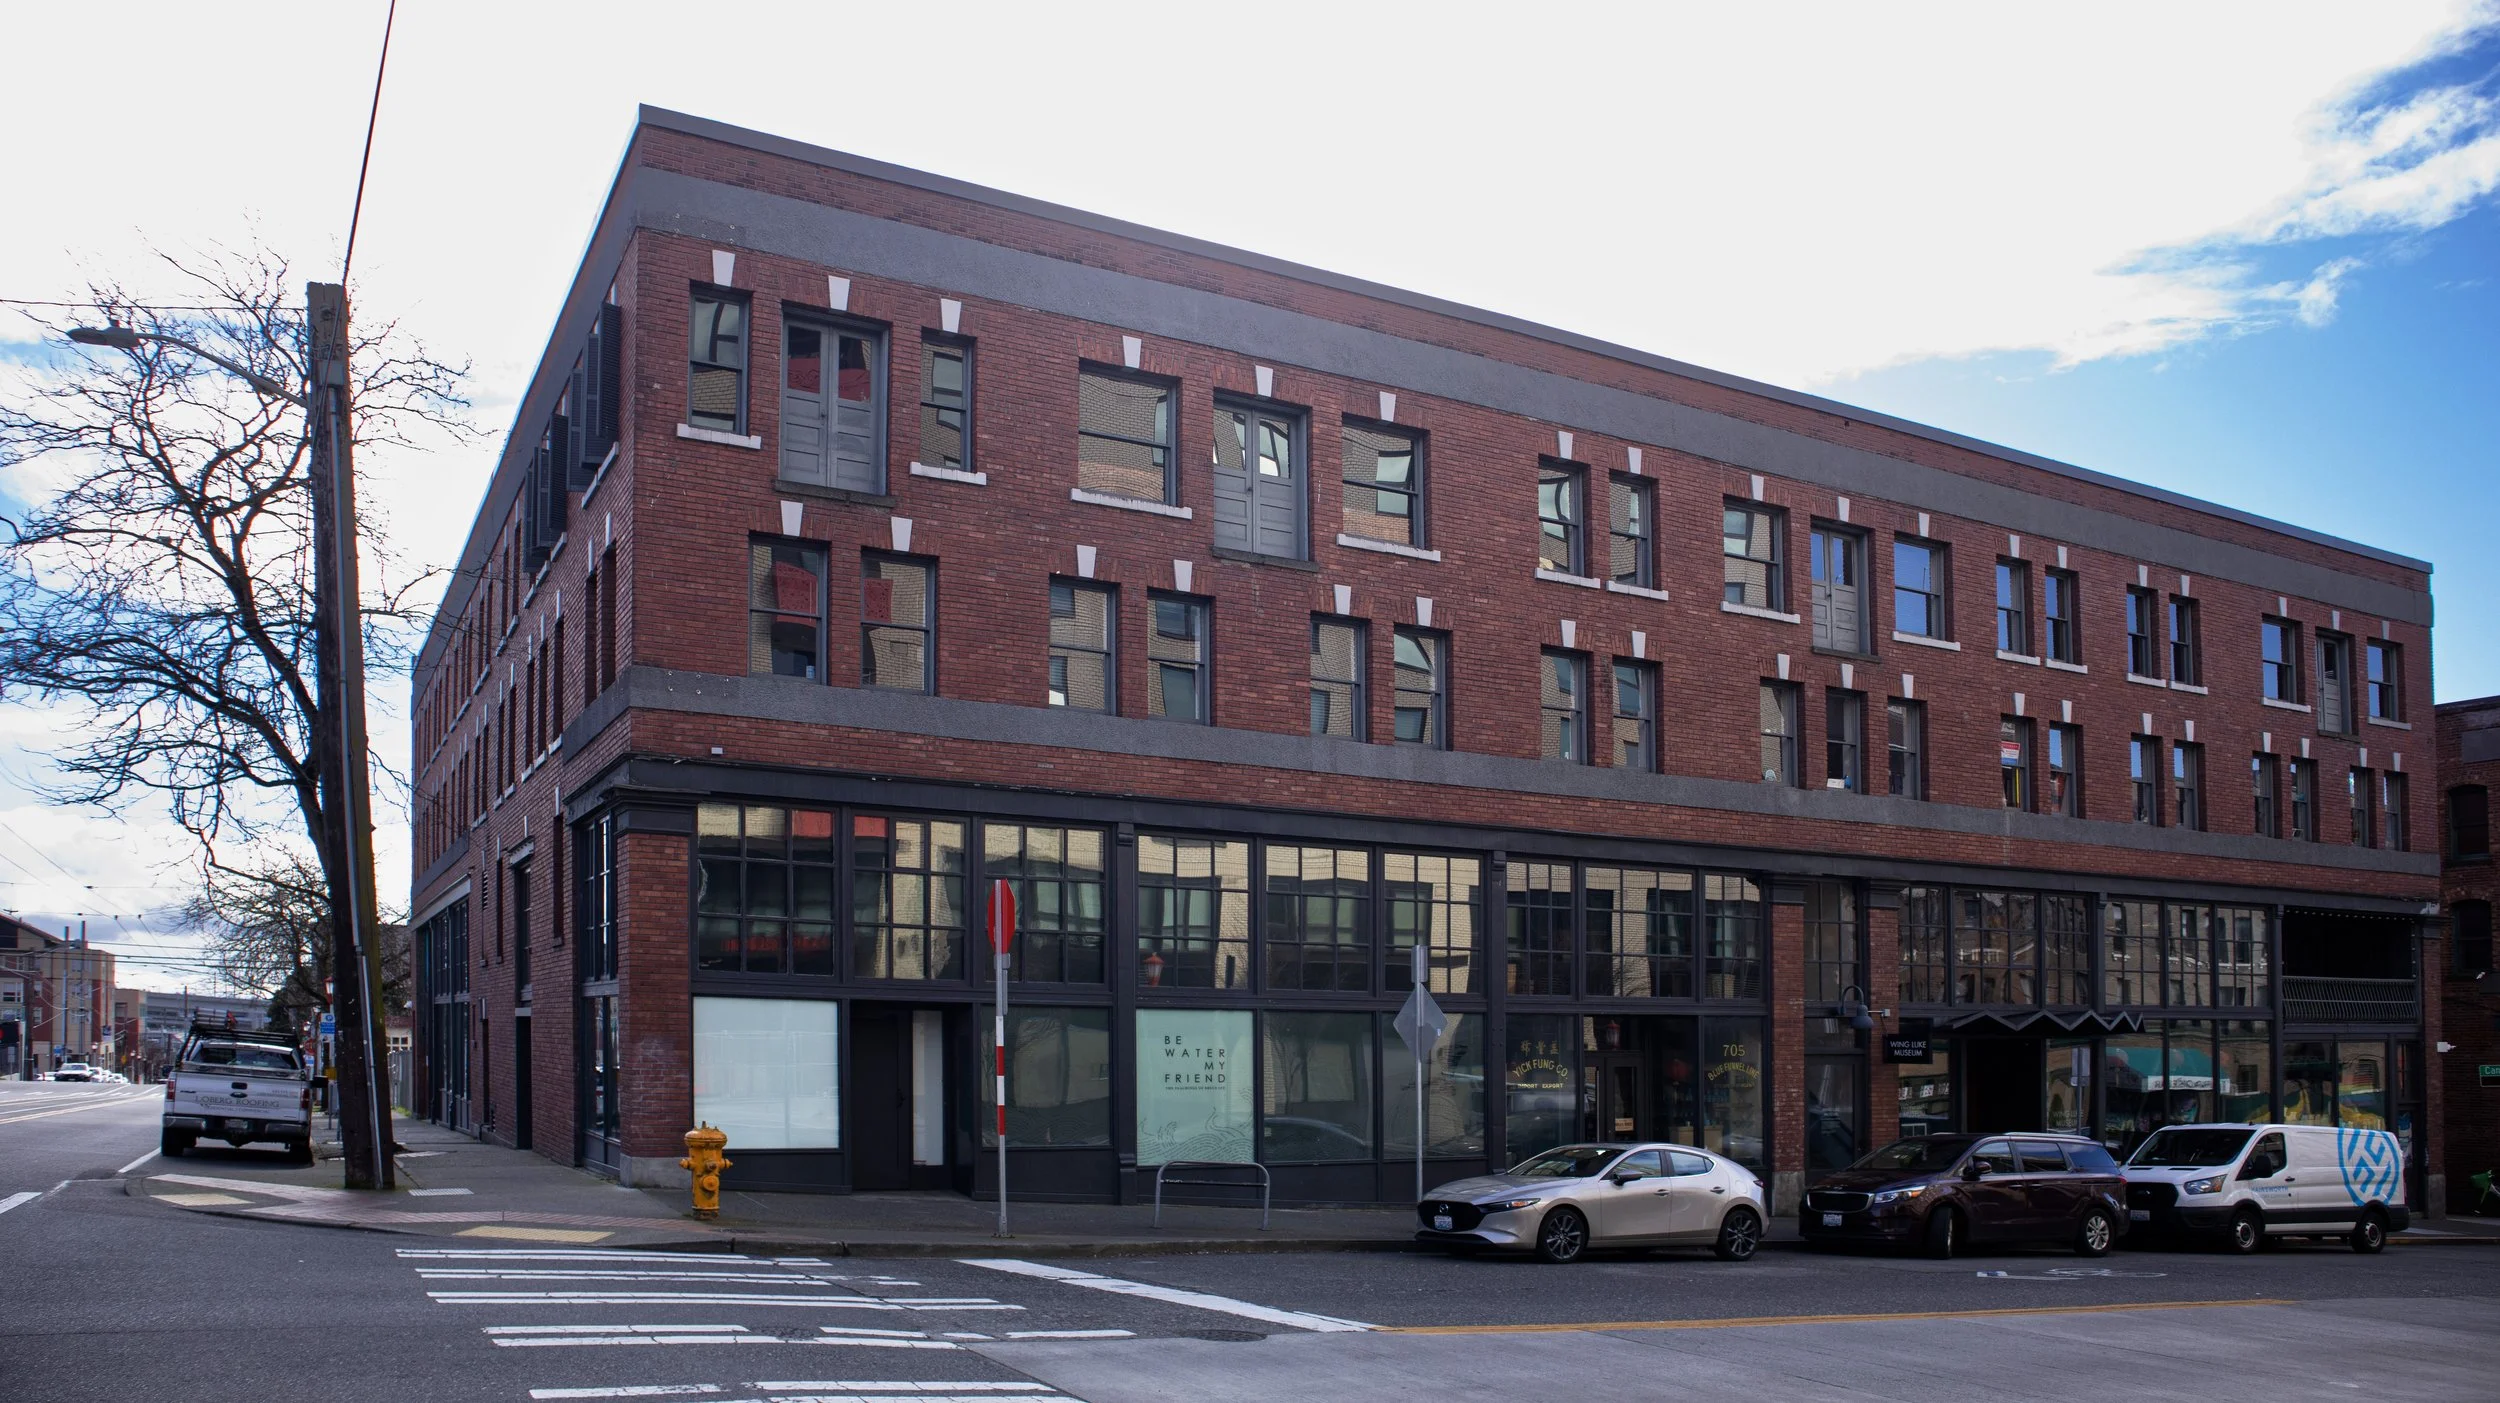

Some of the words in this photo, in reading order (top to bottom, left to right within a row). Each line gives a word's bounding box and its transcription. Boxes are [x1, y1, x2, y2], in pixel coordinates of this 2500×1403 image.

[1164, 1035, 1182, 1045] BE
[1890, 1040, 1910, 1048] WING
[1911, 1040, 1927, 1049] LUKE
[1164, 1048, 1225, 1058] WATER
[1722, 1044, 1746, 1057] 705
[1893, 1049, 1923, 1057] MUSEUM
[1204, 1061, 1225, 1071] MY
[1512, 1060, 1532, 1077] YICK
[1532, 1059, 1555, 1070] FUNG
[1556, 1064, 1568, 1080] CO.
[1707, 1064, 1724, 1081] BLUE
[1164, 1073, 1226, 1083] FRIEND
[195, 1096, 232, 1105] LOBERG
[236, 1098, 280, 1108] ROOFING
[2056, 1119, 2079, 1127] MUSEU
